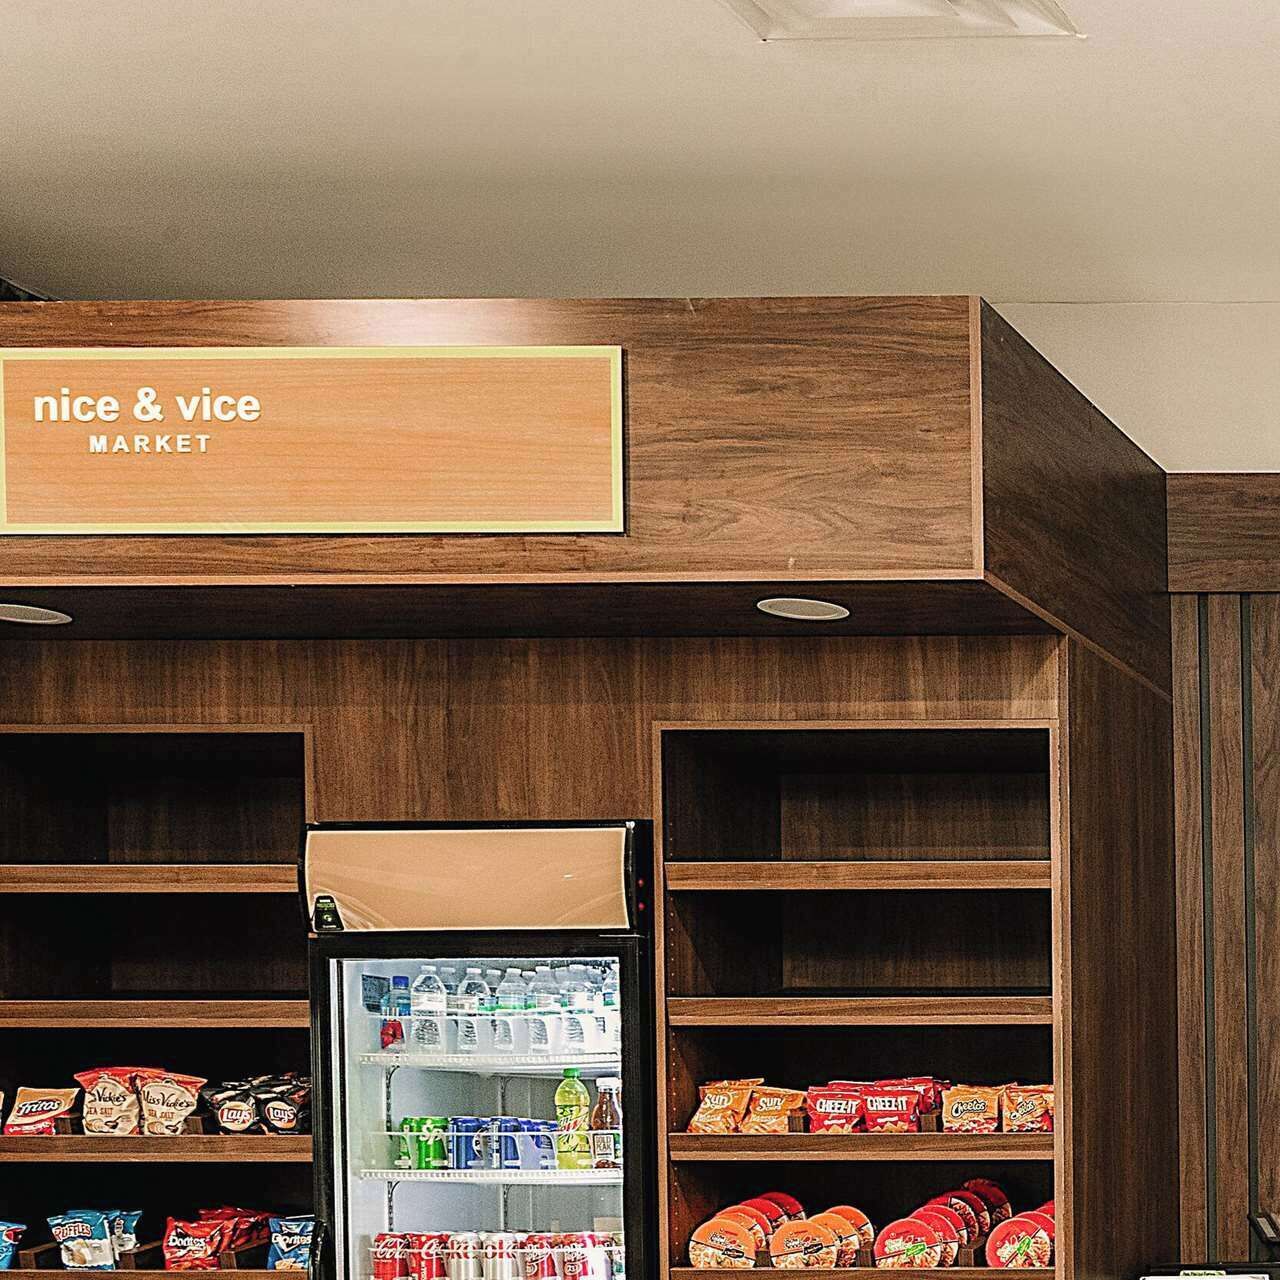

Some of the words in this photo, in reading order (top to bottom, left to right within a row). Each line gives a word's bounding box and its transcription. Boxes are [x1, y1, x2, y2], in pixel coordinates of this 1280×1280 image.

[34, 387, 120, 422] nice
[133, 386, 165, 422] &
[176, 387, 261, 422] vice
[89, 434, 211, 453] MARKET
[16, 1100, 61, 1116] Fritos
[952, 1099, 986, 1118] Cheetos
